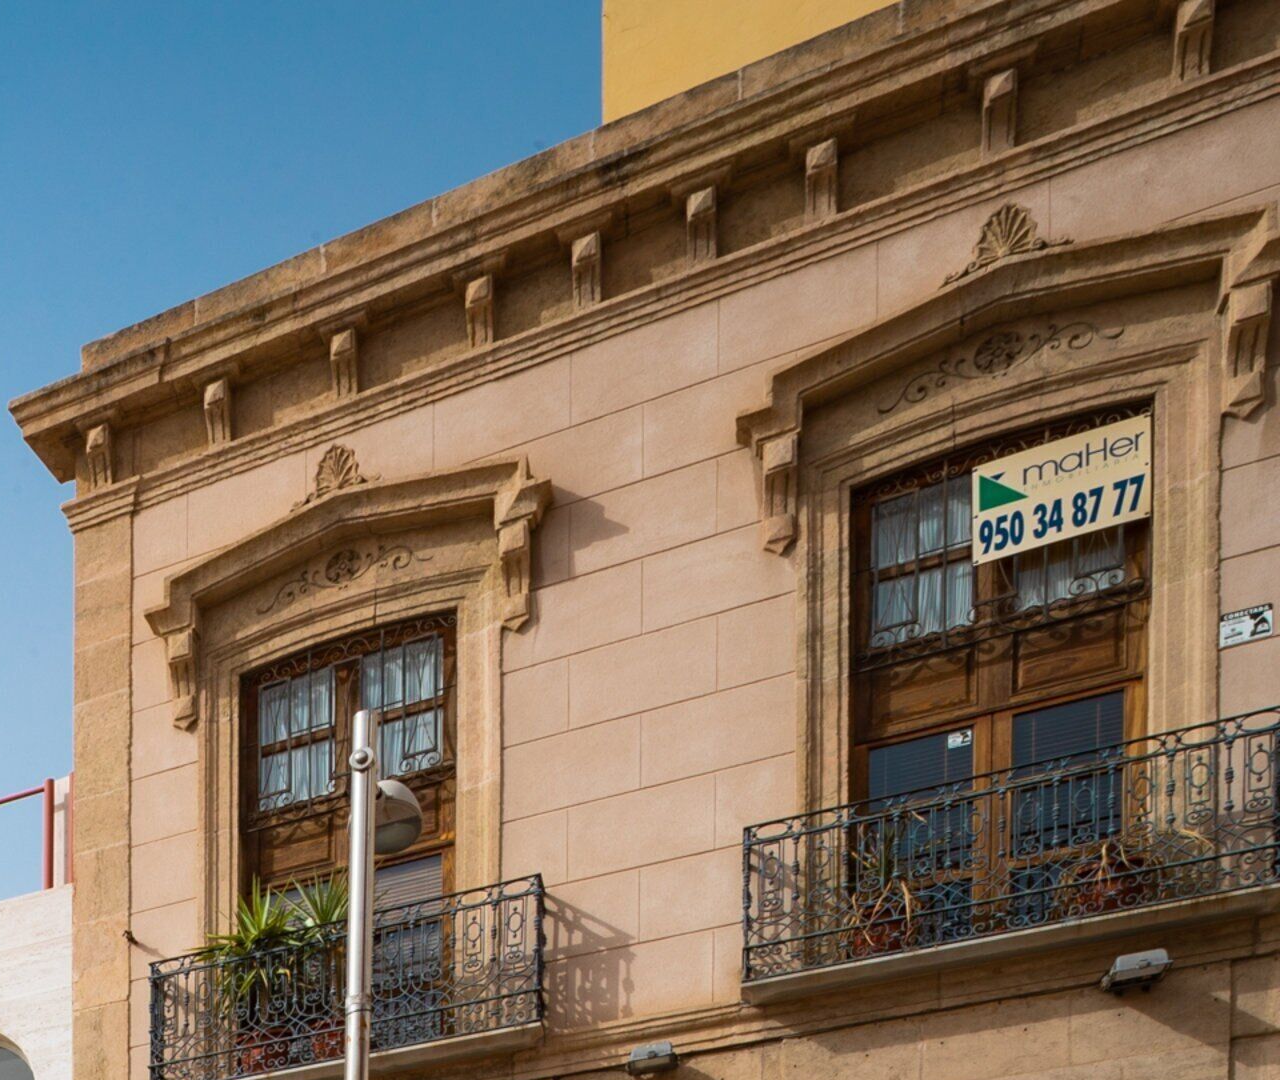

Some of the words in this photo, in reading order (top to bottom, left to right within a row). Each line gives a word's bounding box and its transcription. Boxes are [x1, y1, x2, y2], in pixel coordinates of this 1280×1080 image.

[1023, 431, 1145, 486] maHer
[979, 510, 1025, 555] 950
[1033, 498, 1064, 540] 34
[1072, 485, 1105, 528] 87
[1113, 473, 1146, 517] 77
